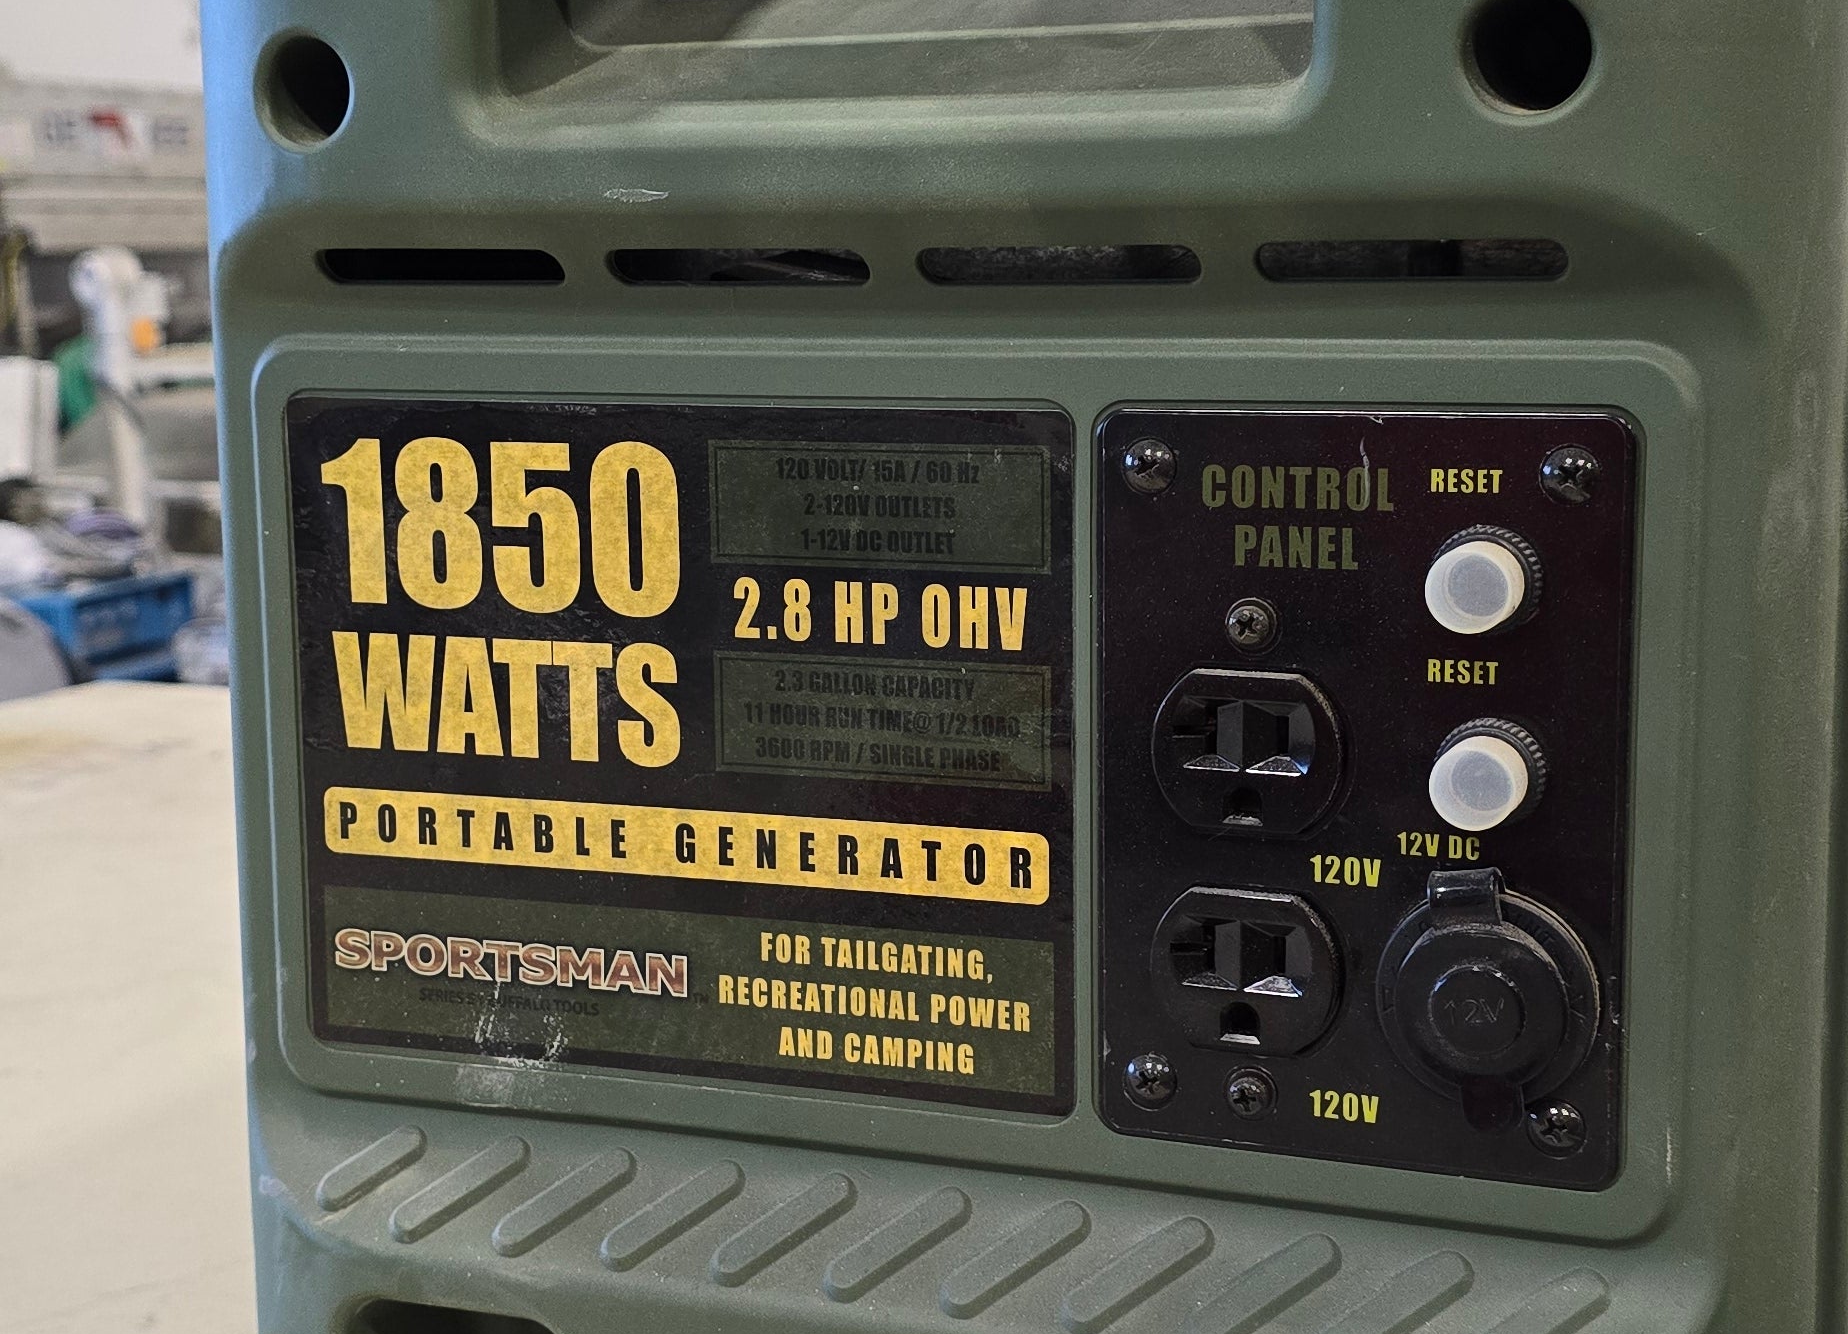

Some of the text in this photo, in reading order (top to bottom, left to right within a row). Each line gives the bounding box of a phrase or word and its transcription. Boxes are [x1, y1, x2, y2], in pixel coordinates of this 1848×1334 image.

[776, 457, 809, 480] 120
[873, 460, 907, 483] 15A
[926, 460, 952, 484] 60
[1202, 463, 1395, 512] CONTROL
[1430, 468, 1503, 495] RESET
[804, 493, 956, 519] 2-120V OUTLETS
[321, 436, 681, 618] 1850
[800, 528, 956, 555] 1-12V DC OUTLET
[1234, 524, 1359, 570] PANEL
[733, 576, 1028, 651] 2.8 HP OHV
[775, 669, 975, 701] 2.3 GALLON CAPACITY
[1427, 658, 1499, 686] RESET
[332, 631, 681, 768] WATTS
[743, 701, 764, 724] 11
[768, 703, 821, 727] HOUR
[825, 706, 863, 730] RUN
[937, 714, 967, 737] 1/2
[755, 736, 806, 760] 3600
[809, 739, 850, 764] RPM
[869, 742, 935, 768] SINGLE
[939, 746, 1002, 772] PHASE
[339, 801, 1032, 889] PORTABLE GENERATOR
[1397, 831, 1481, 861] 12V DC
[1310, 854, 1382, 888] 120V
[335, 928, 688, 998] SPORTSMAN
[760, 932, 994, 984] FOR TAILGATING,
[551, 998, 600, 1016] TOOLS
[718, 974, 1030, 1033] RECREATIONAL POWER
[1443, 997, 1505, 1026] 12V
[778, 1026, 975, 1075] AND CAMPING
[1310, 1090, 1380, 1124] 120V
